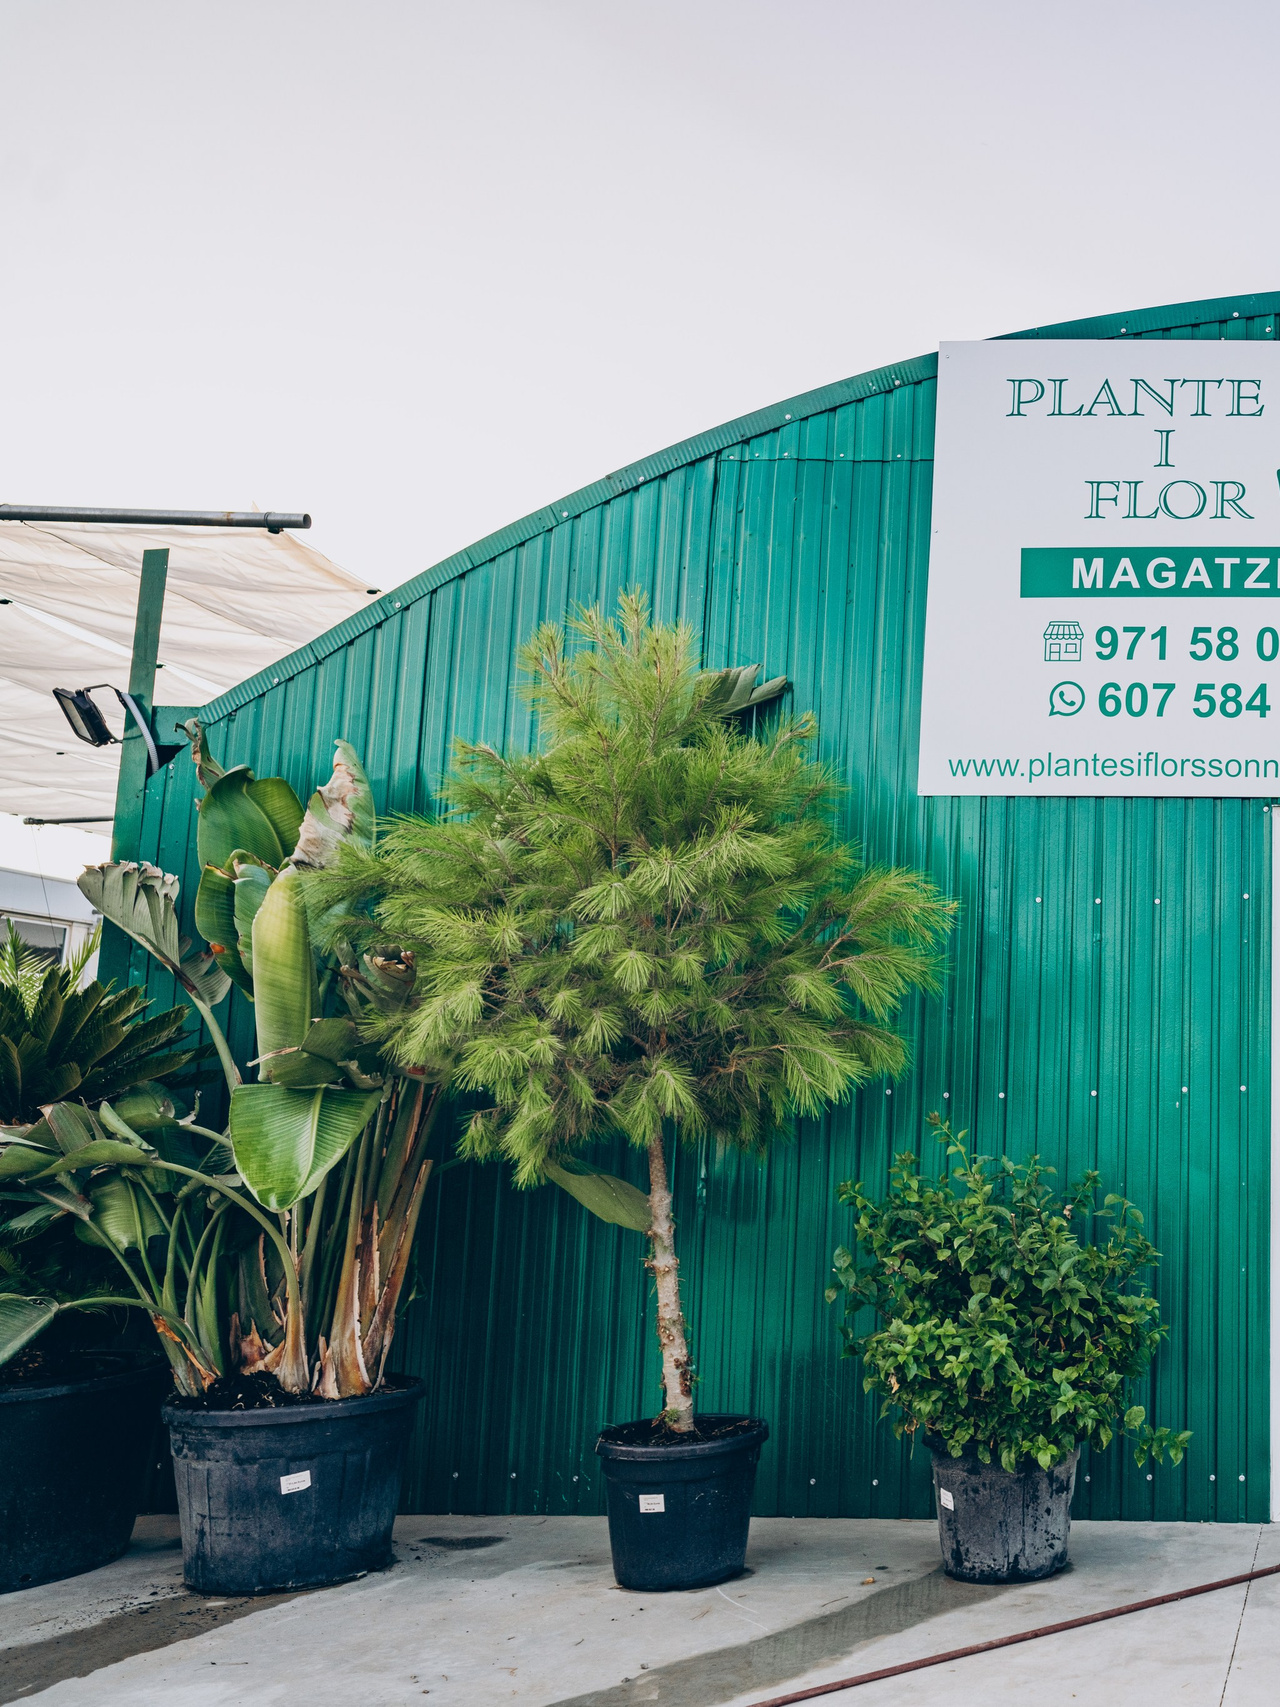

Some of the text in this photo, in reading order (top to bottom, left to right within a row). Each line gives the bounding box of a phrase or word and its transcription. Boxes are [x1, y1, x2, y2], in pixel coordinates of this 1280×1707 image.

[1006, 378, 1265, 417] PLANTE
[1153, 429, 1176, 468] I
[1084, 480, 1255, 520] FLOR
[1094, 625, 1168, 661] 971
[1188, 625, 1240, 662] 58
[1098, 681, 1177, 718] 607
[1192, 682, 1272, 719] 584
